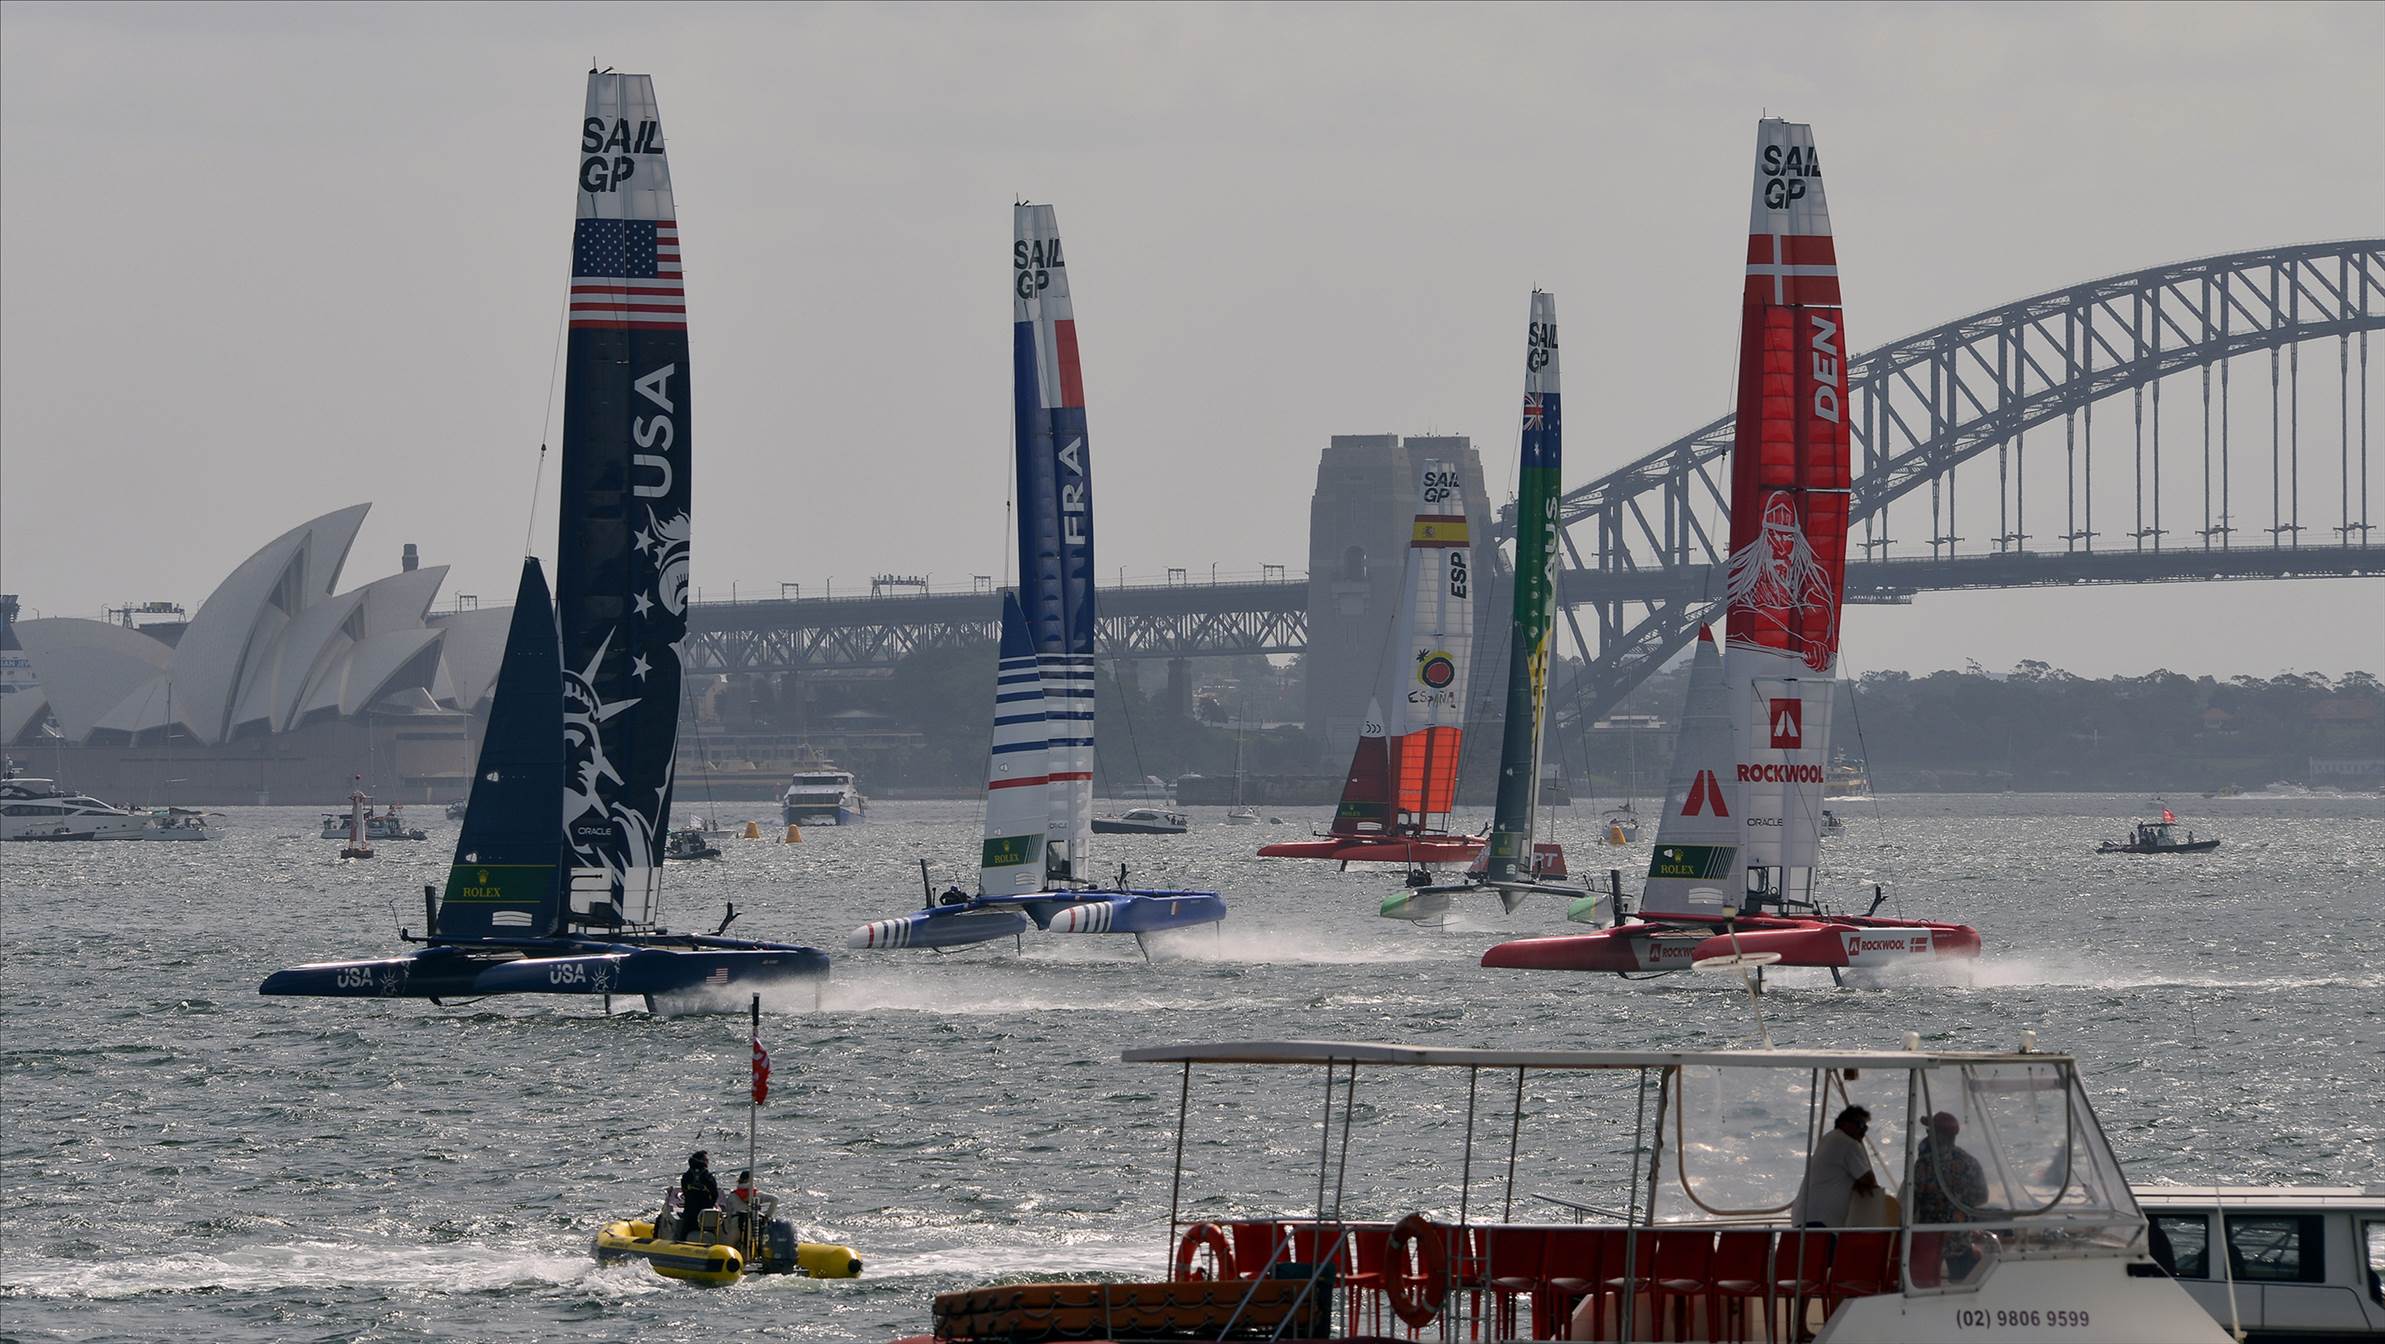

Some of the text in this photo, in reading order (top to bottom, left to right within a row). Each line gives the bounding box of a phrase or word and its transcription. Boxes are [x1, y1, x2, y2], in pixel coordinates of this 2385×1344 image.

[582, 117, 664, 154] SAIL
[1761, 145, 1821, 176] SAIL
[579, 156, 634, 192] GP
[1764, 178, 1806, 209] GP
[1014, 239, 1064, 269] SAIL
[1017, 270, 1049, 299] GP
[1529, 322, 1558, 349] SAIL
[1528, 348, 1549, 373] GP
[1811, 316, 1839, 423] DEN
[633, 363, 675, 498] USA
[1059, 437, 1086, 545] FRA
[1424, 472, 1459, 487] SAIL
[1424, 488, 1450, 503] GP
[1451, 552, 1467, 599] ESP
[1737, 764, 1824, 783] ROCKWOOL
[578, 827, 612, 836] ORACLE
[1747, 818, 1783, 827] ORACLE
[1661, 864, 1694, 875] ROLEX
[463, 887, 501, 897] ROLEX
[1861, 940, 1905, 951] ROCKWOOL
[337, 967, 373, 988] USA
[550, 964, 586, 984] USA
[1956, 1309, 2089, 1329] (02) 9806 9599
